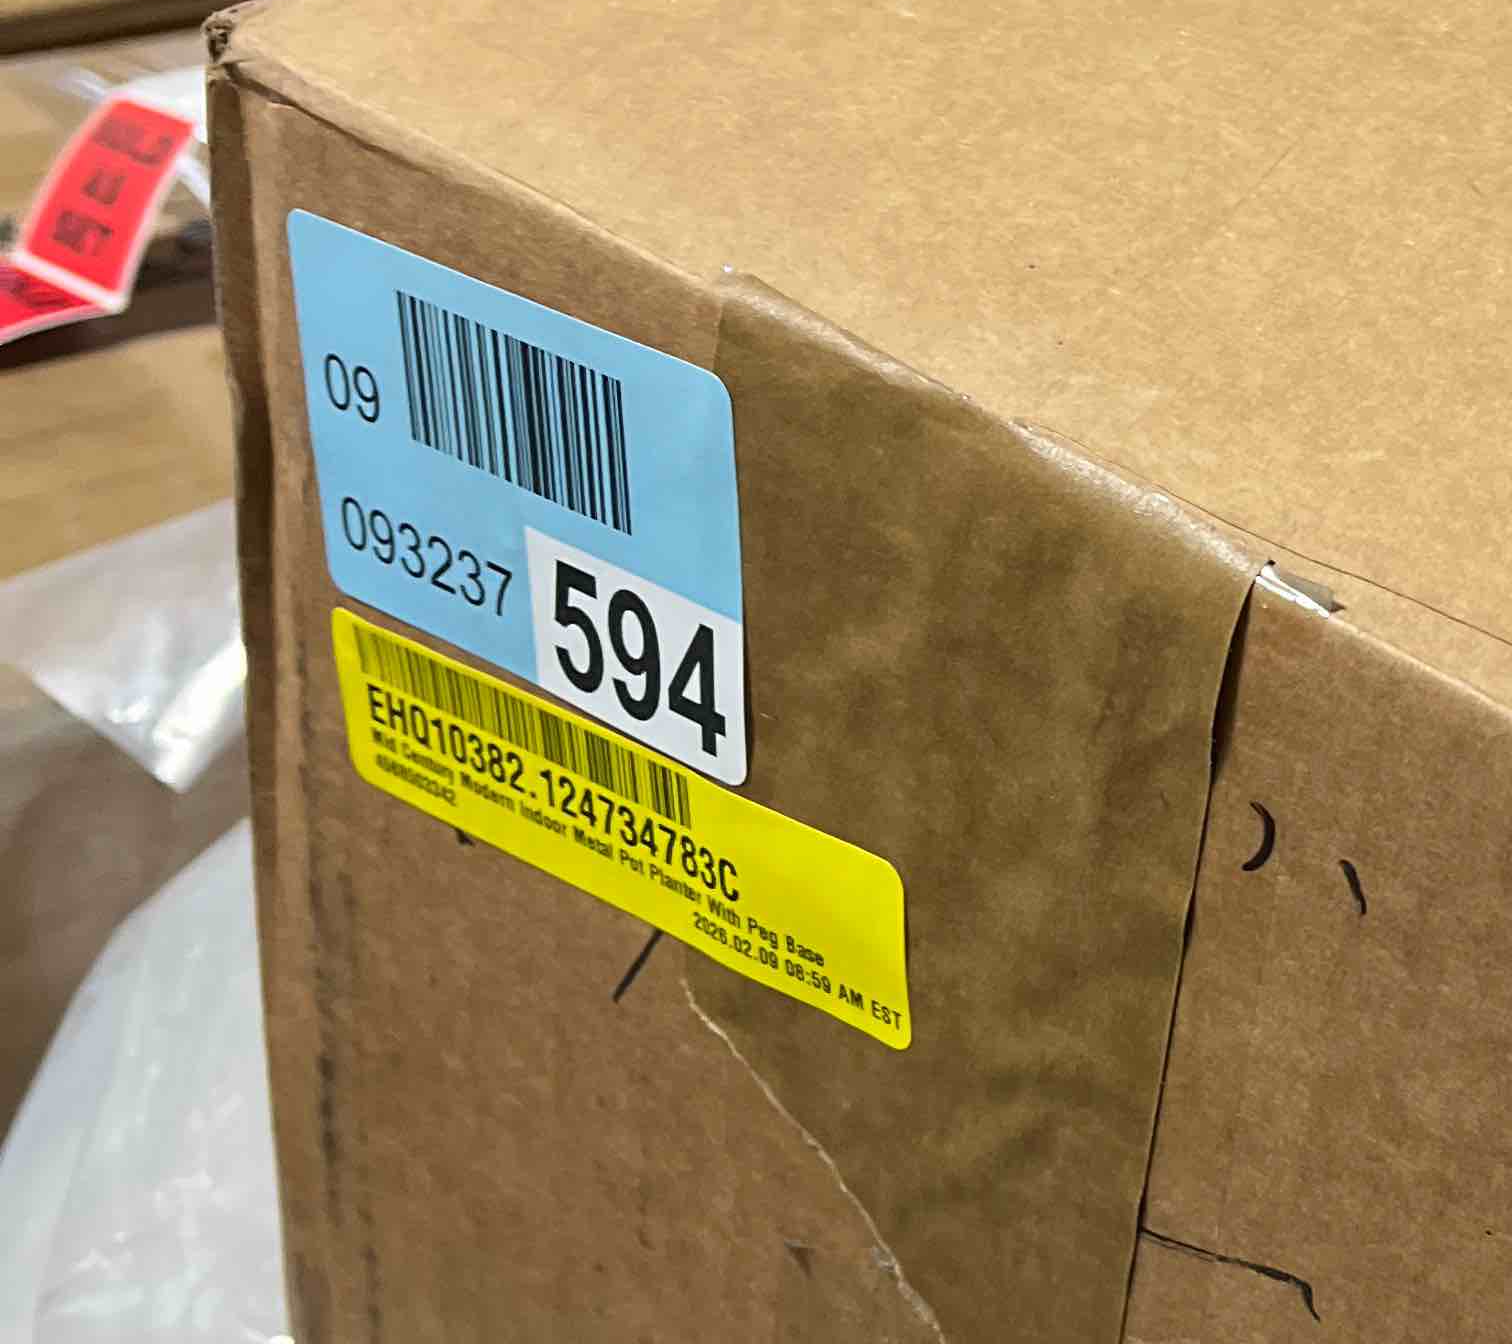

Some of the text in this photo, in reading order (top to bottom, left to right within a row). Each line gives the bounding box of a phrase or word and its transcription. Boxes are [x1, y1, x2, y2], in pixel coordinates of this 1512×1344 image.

[324, 353, 380, 424] 09
[341, 497, 727, 757] 093237 594
[461, 772, 514, 812] Modern
[520, 804, 566, 836] Indoor
[573, 825, 614, 860] Metal
[649, 864, 702, 906] Planter
[707, 894, 741, 928] With
[748, 917, 779, 950] Peg
[786, 936, 825, 967] Base
[839, 983, 865, 1011] AM
[872, 999, 902, 1031] EST
